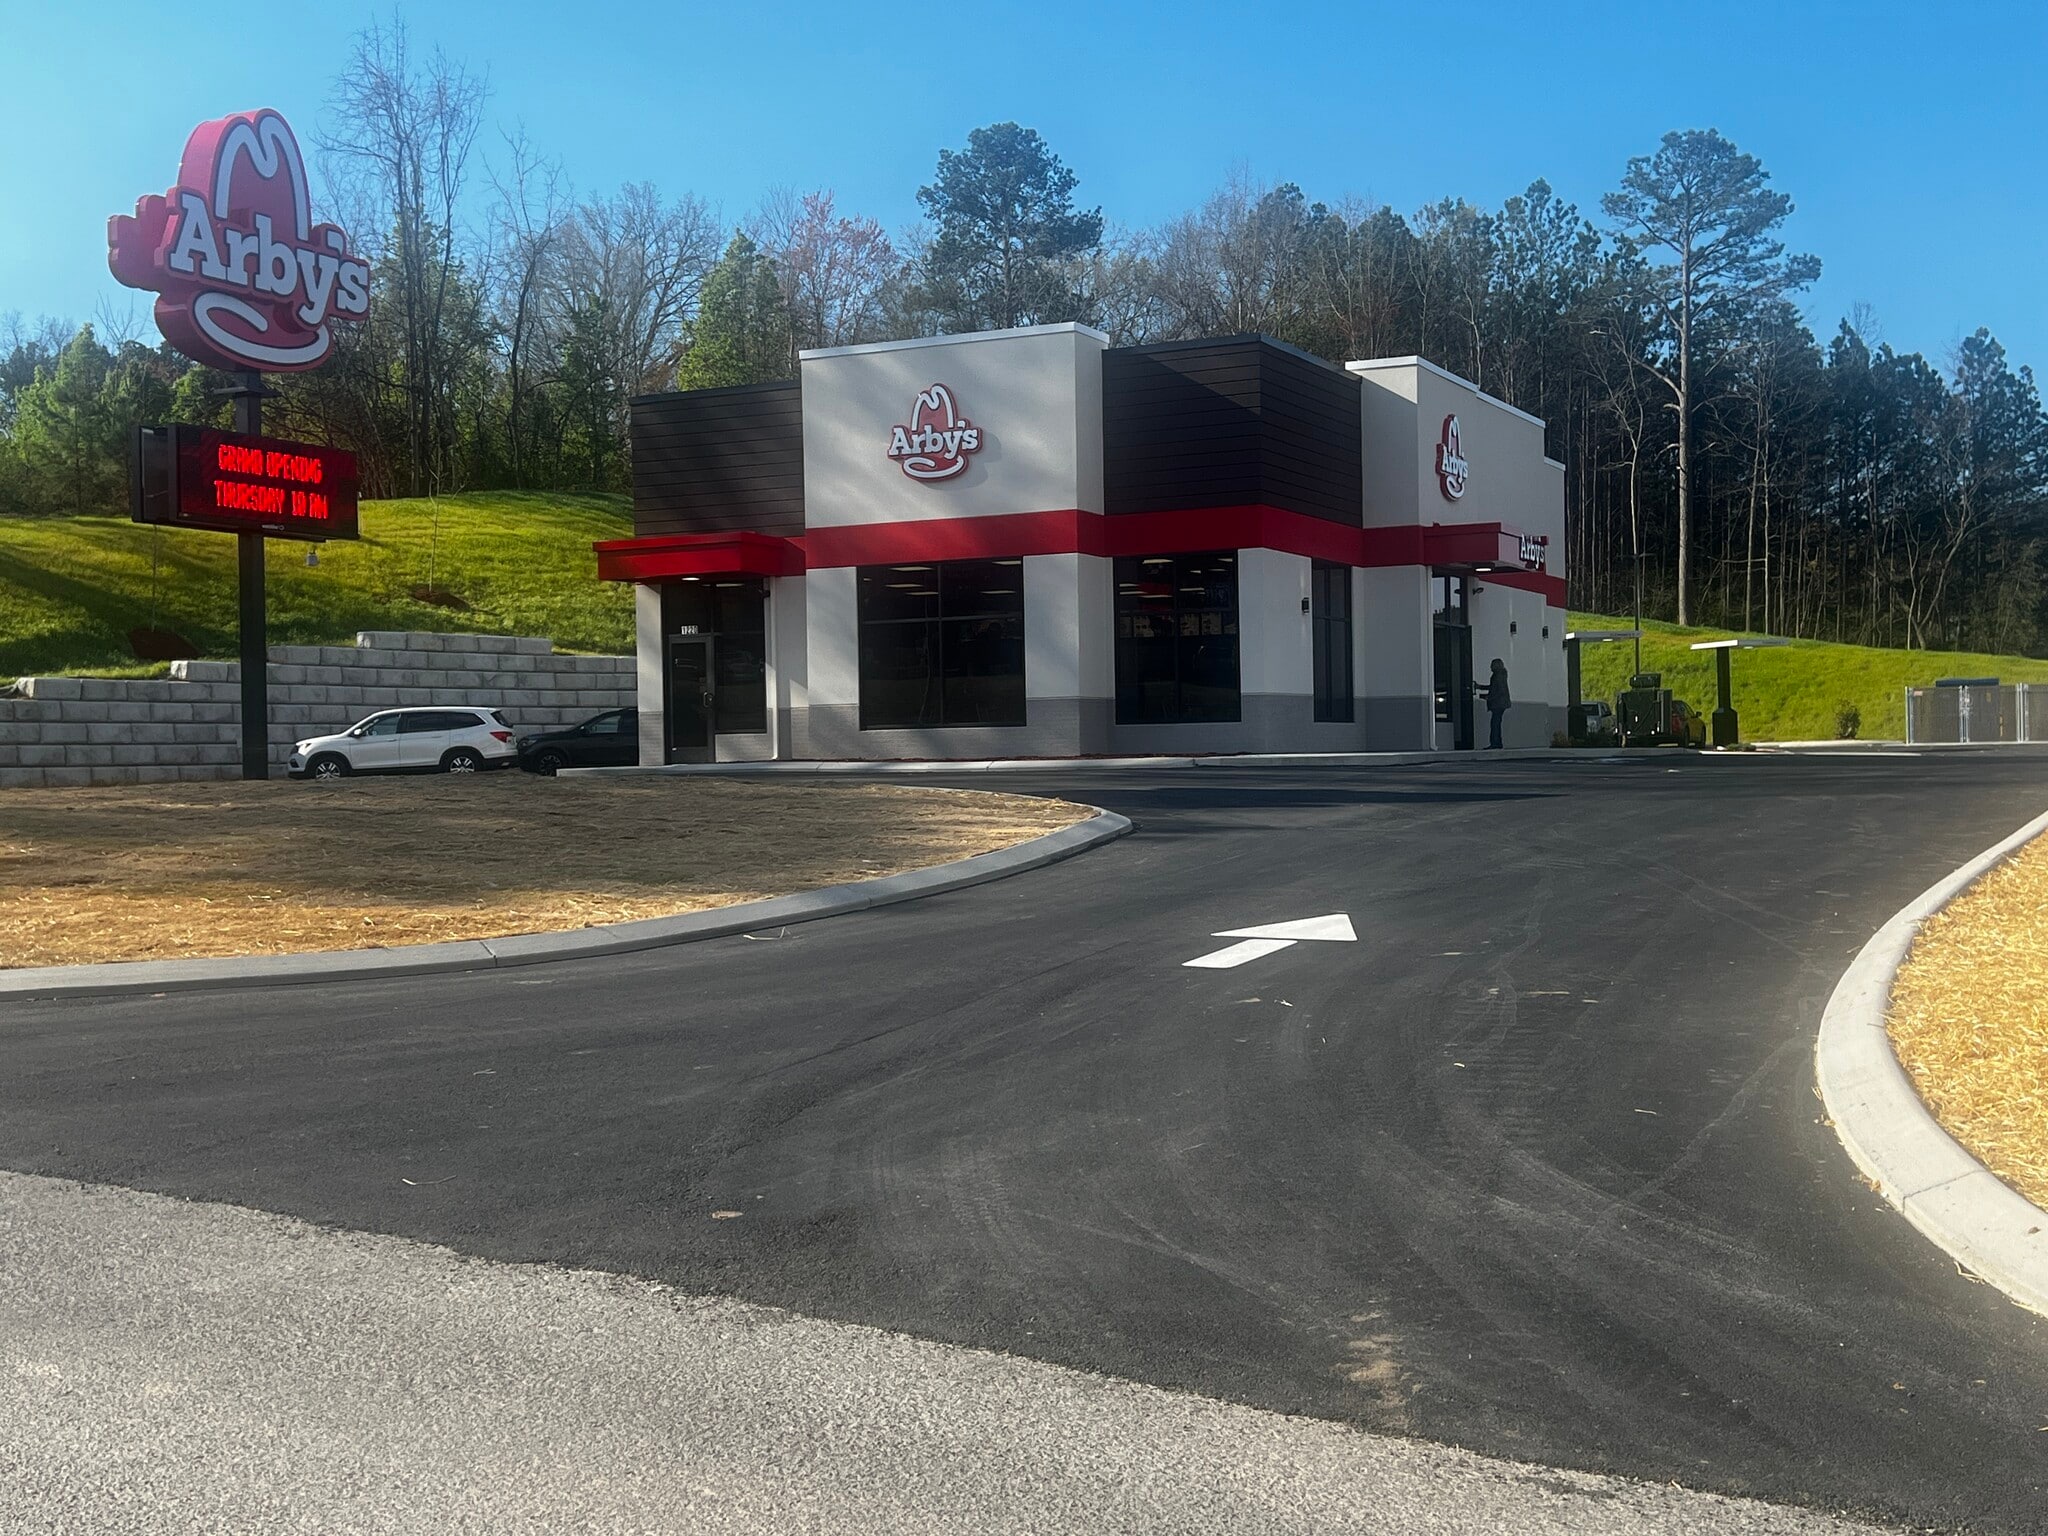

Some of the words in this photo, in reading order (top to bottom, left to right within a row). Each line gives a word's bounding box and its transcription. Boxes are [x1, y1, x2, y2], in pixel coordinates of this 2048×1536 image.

[170, 192, 369, 325] Arby's
[888, 420, 978, 459] Arby's
[218, 444, 263, 475] GRAND
[266, 451, 323, 484] OPENING
[1441, 444, 1468, 483] Arby's
[214, 480, 285, 514] THURSDAY
[291, 490, 307, 517] 10
[1520, 533, 1545, 569] Arby's
